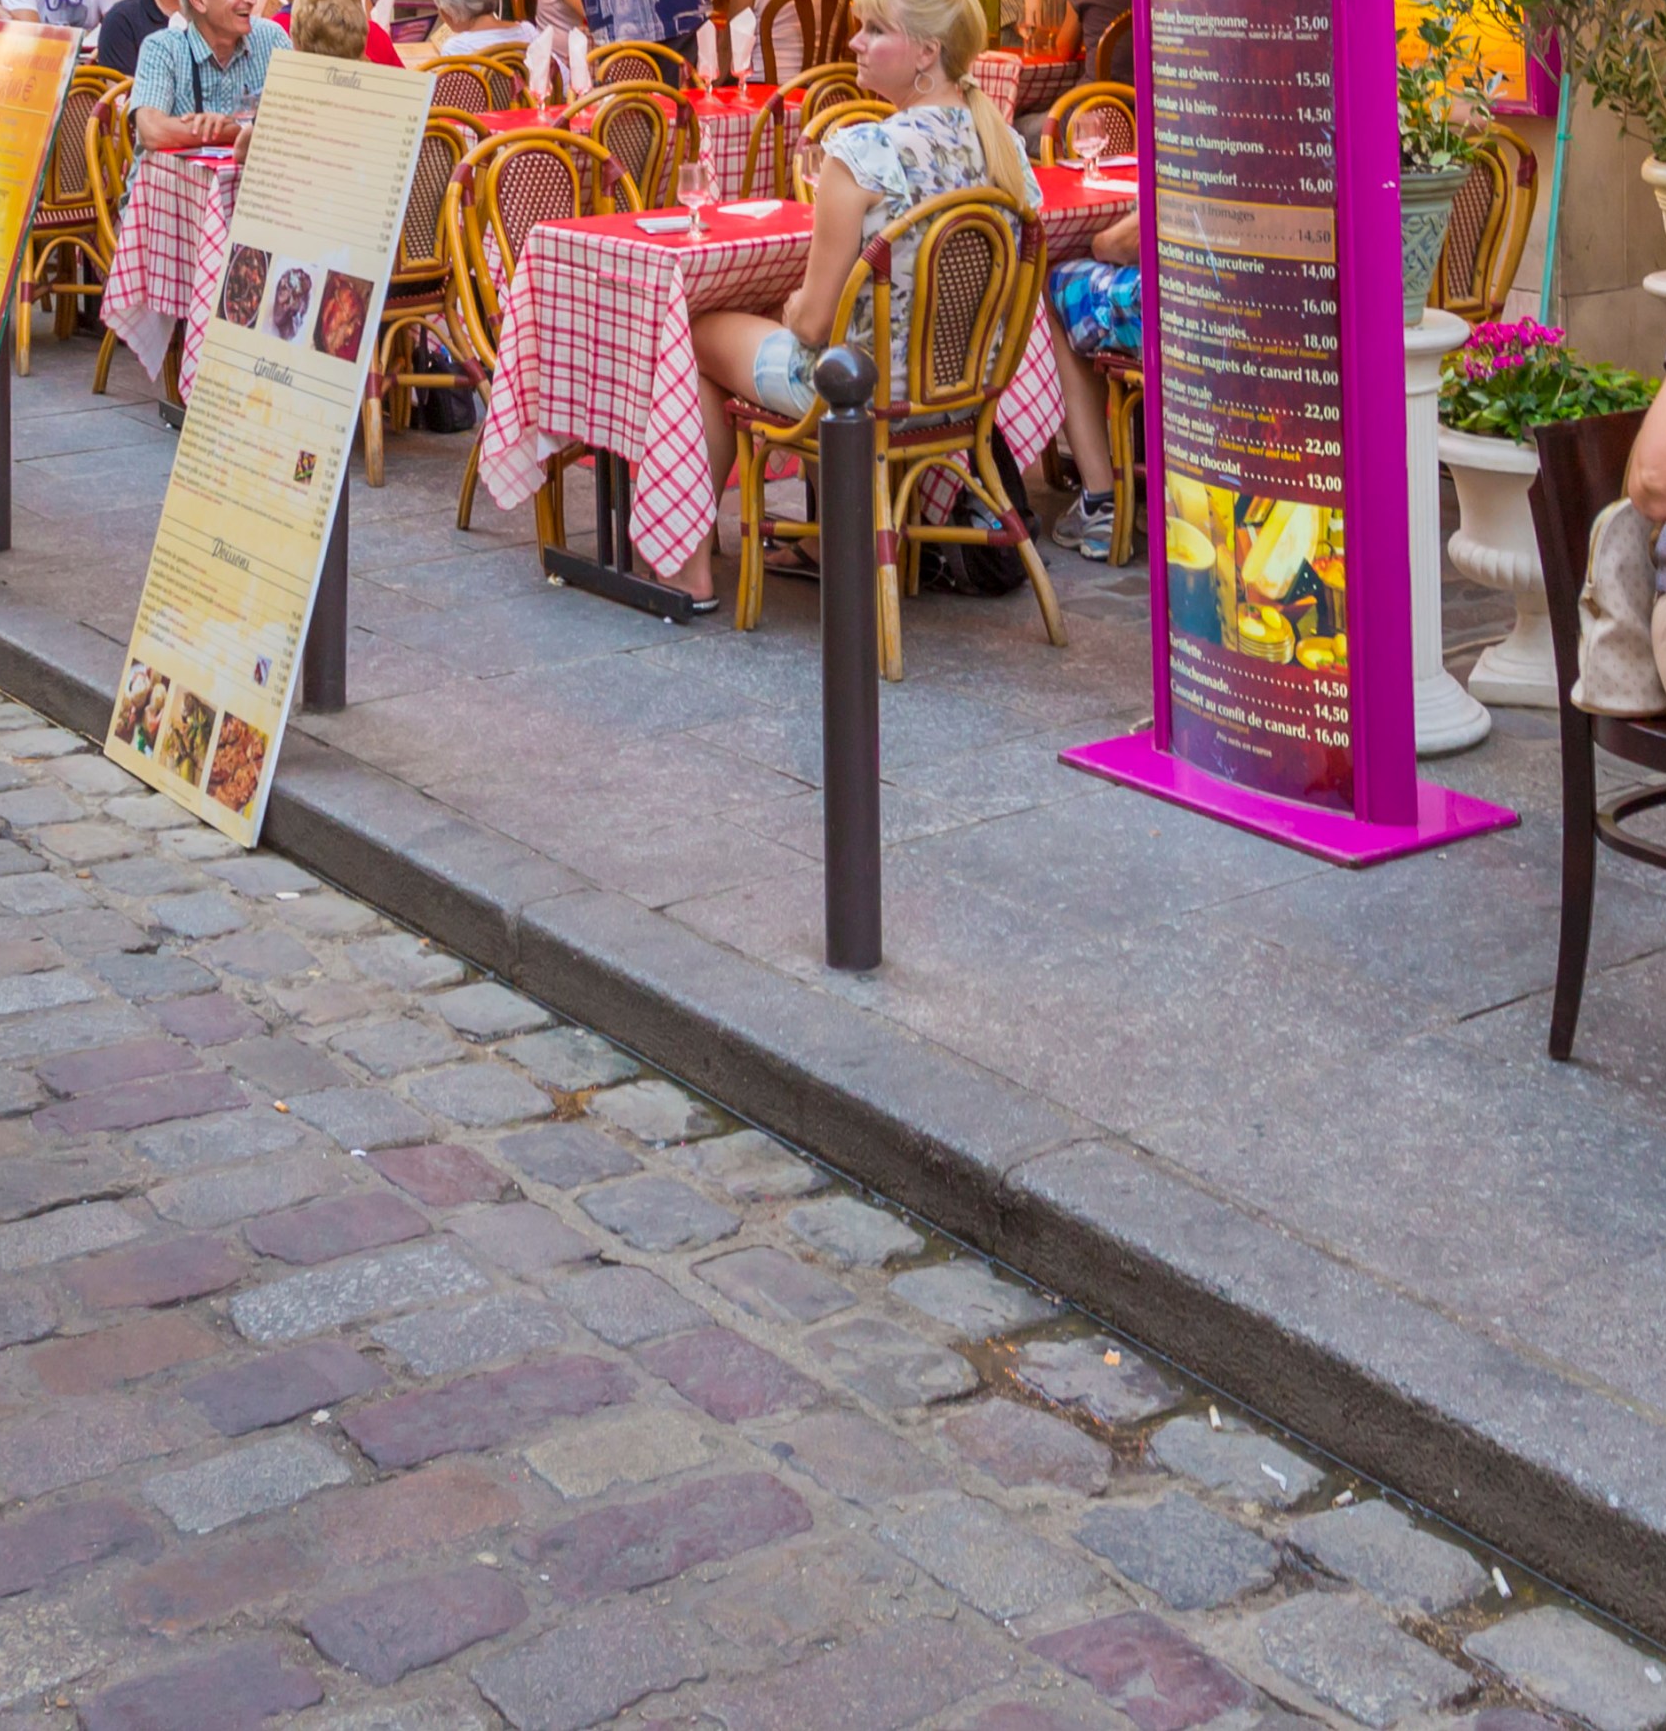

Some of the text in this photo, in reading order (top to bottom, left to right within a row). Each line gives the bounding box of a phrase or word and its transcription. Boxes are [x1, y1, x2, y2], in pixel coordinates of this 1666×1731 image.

[1295, 15, 1330, 31] 15,00
[1296, 72, 1331, 88] 15,50
[1297, 108, 1331, 124] 14,50
[1196, 134, 1332, 158] champignons 15,00
[1192, 168, 1333, 193] roquefort 16,00
[1298, 229, 1331, 245] 14,50
[1206, 253, 1265, 274] charcuterie
[1301, 264, 1336, 280] 14,00
[1302, 299, 1337, 315] 16,00
[1303, 333, 1338, 350] 18,00
[1202, 355, 1339, 386] magrets de canard 18,00
[1304, 403, 1340, 421] 22,00
[1305, 438, 1341, 457] 22,00
[1200, 454, 1342, 492] chocolat 13,00
[1313, 679, 1348, 699] 14,50
[1314, 704, 1349, 724] 14,50
[1218, 702, 1246, 721] confit
[1248, 712, 1262, 728] de
[1264, 719, 1305, 739] canard
[1315, 728, 1350, 748] 16,00
